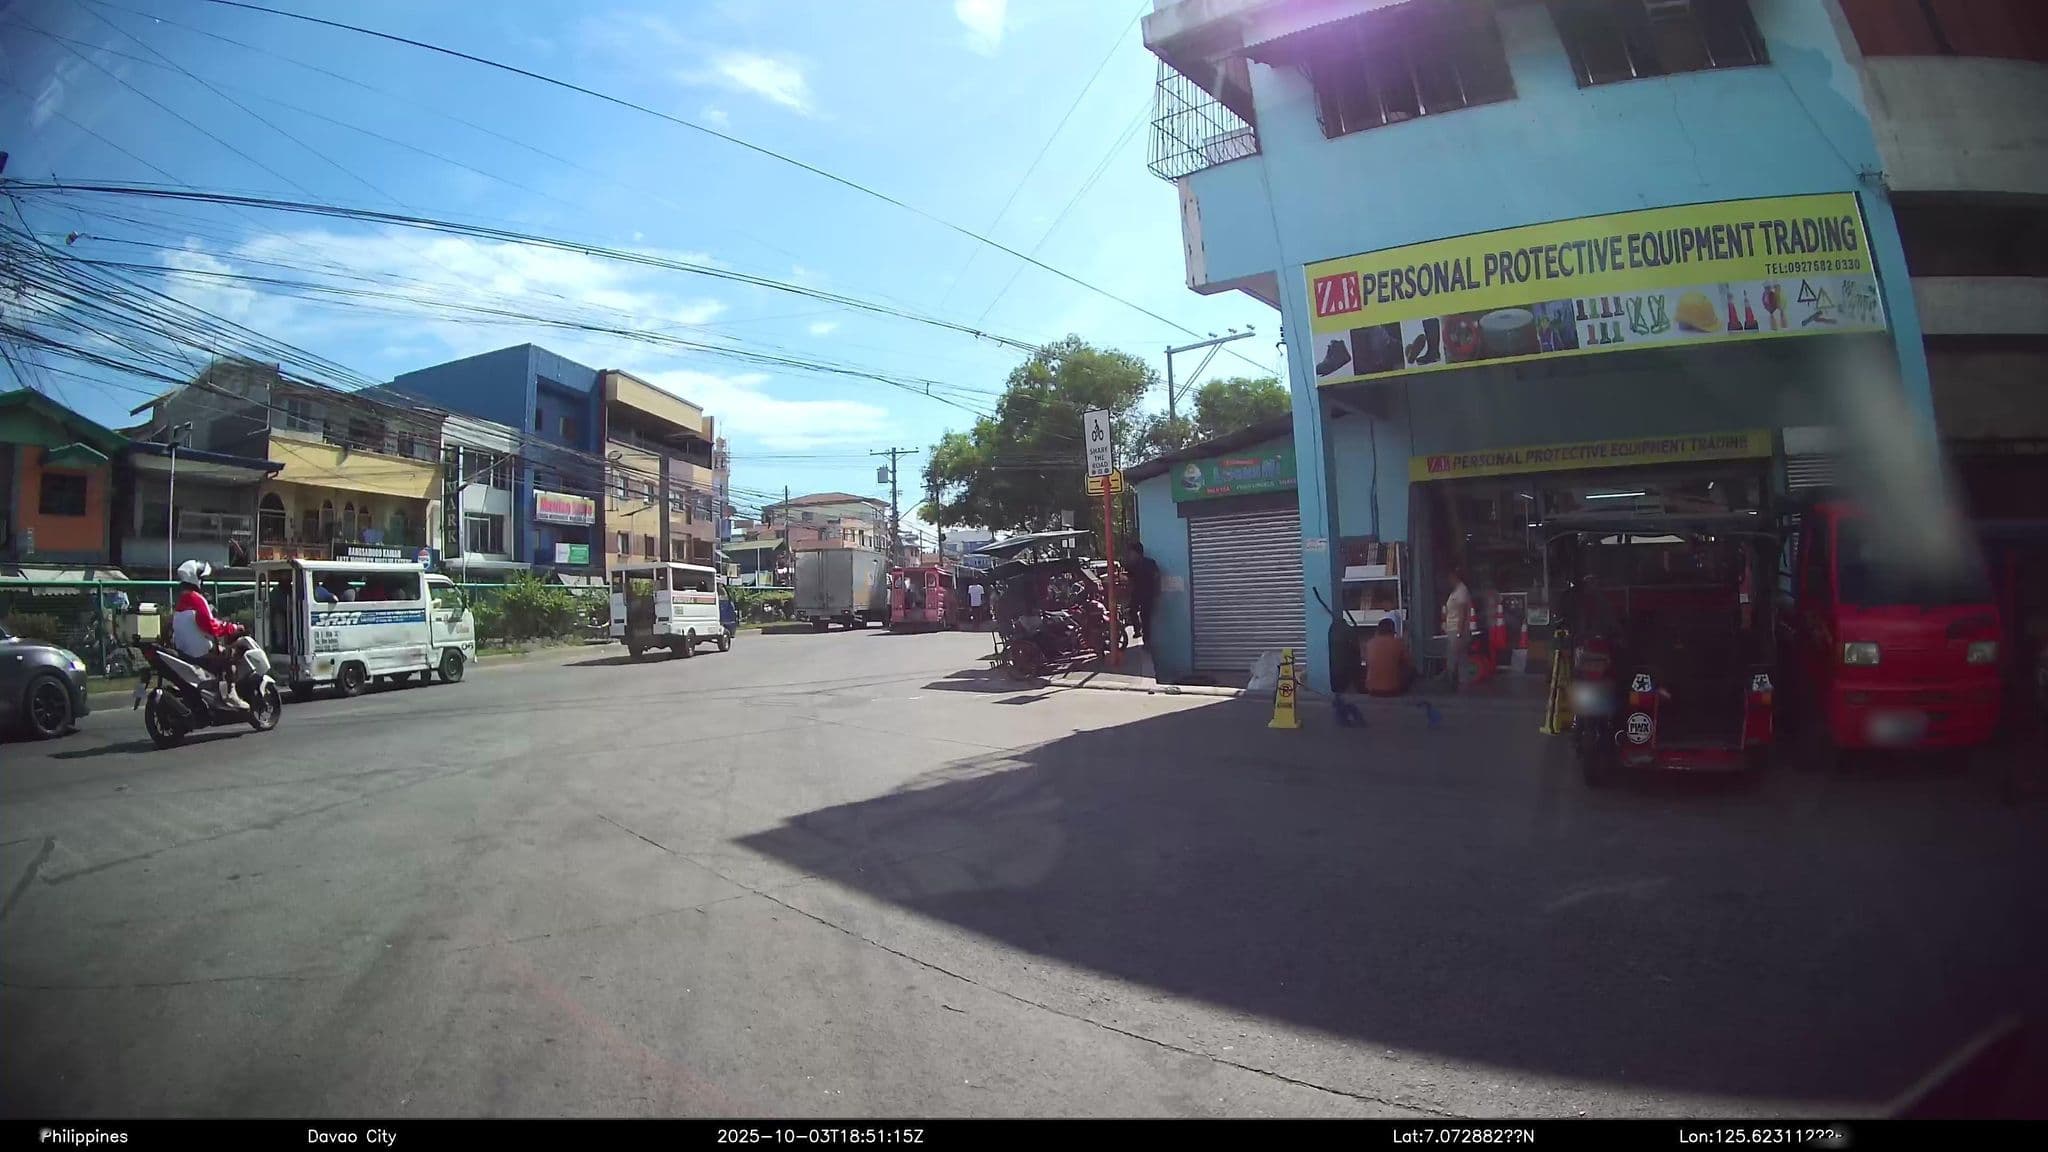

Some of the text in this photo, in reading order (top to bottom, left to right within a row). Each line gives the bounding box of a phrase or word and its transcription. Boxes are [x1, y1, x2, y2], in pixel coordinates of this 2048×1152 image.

[1362, 256, 1480, 306] PERSONAL
[1484, 236, 1625, 286] PROTECTIVE
[1628, 222, 1755, 269] EQUIPMENT
[1758, 215, 1858, 255] TRADING
[1835, 258, 1861, 271] 0330
[1453, 452, 1522, 470] PERSONAL
[1526, 443, 1606, 464] PROTECTIVE
[1610, 438, 1685, 457] EQUIPMENT
